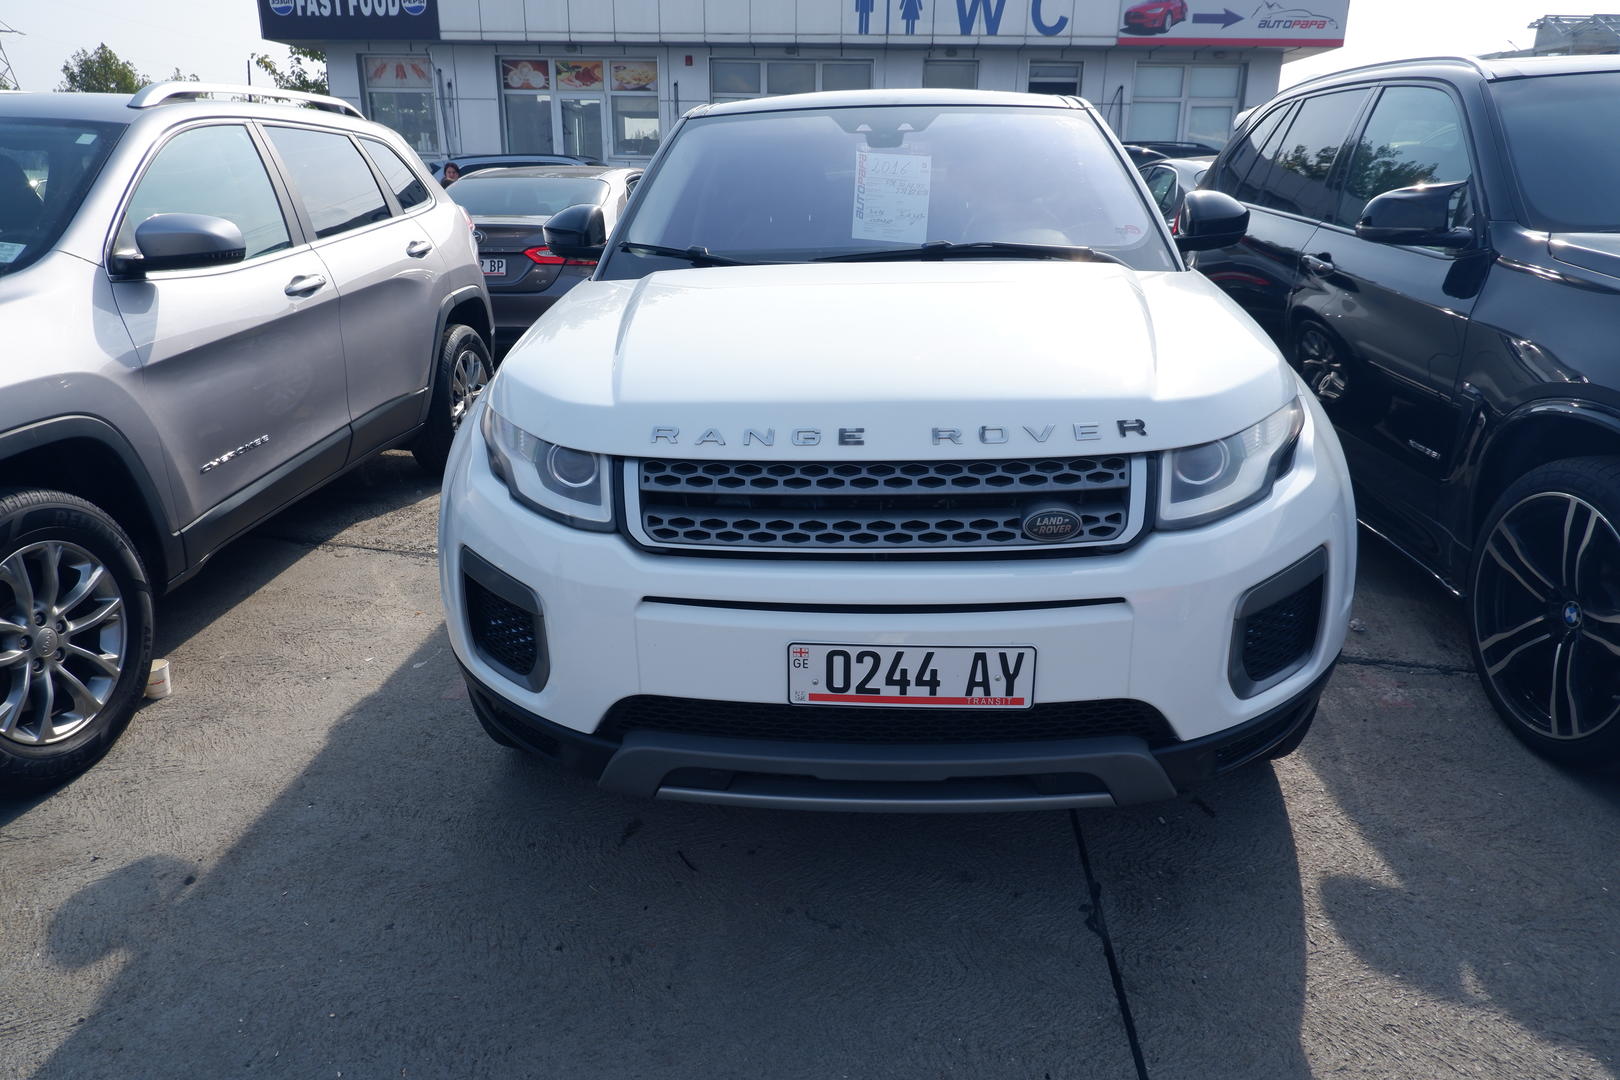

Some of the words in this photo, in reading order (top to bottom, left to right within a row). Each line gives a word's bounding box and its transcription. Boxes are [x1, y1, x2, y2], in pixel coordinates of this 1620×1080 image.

[348, 0, 400, 16] FOOD
[489, 260, 504, 273] BP
[650, 425, 865, 446] RANGE
[931, 419, 1149, 446] ROVER
[793, 658, 809, 669] GE
[826, 649, 941, 696] 0244
[965, 651, 1025, 697] AY
[966, 696, 1012, 705] TRANSIT
